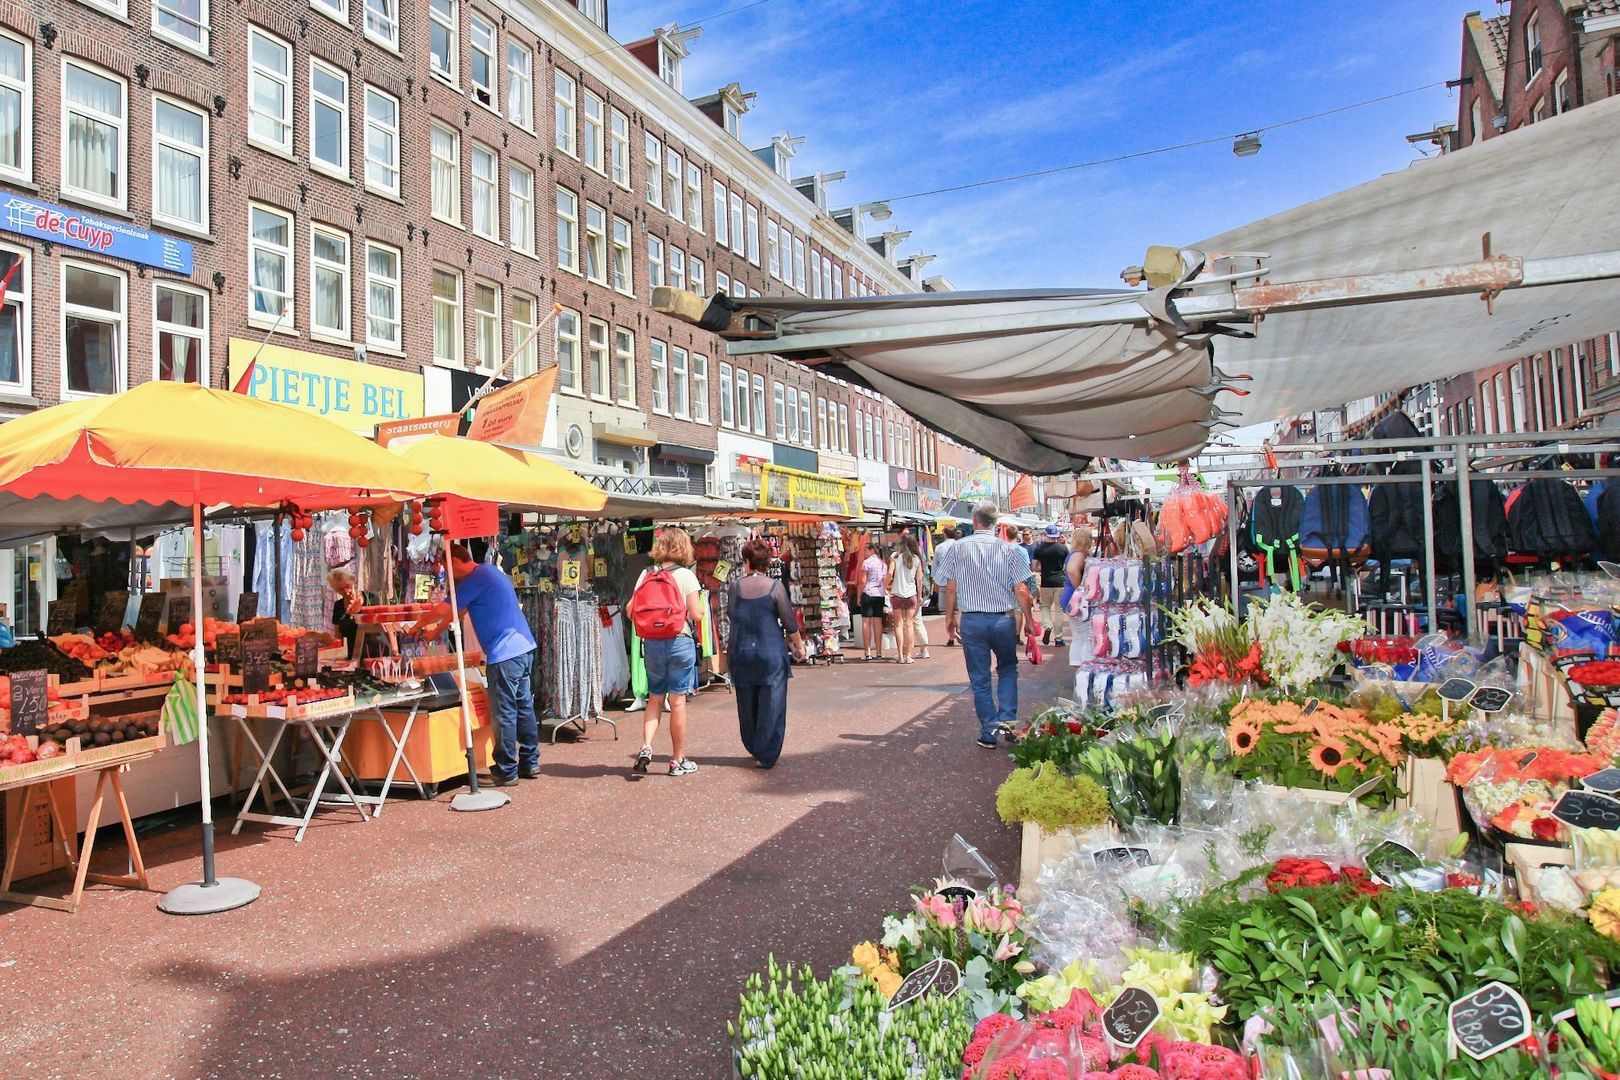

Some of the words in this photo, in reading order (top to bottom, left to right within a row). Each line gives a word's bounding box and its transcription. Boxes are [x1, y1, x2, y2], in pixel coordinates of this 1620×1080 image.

[35, 210, 60, 233] de
[65, 217, 114, 250] Cuyp
[249, 364, 351, 415] PIETJE
[362, 382, 411, 420] BEL
[796, 478, 840, 497] SOUVENIRS
